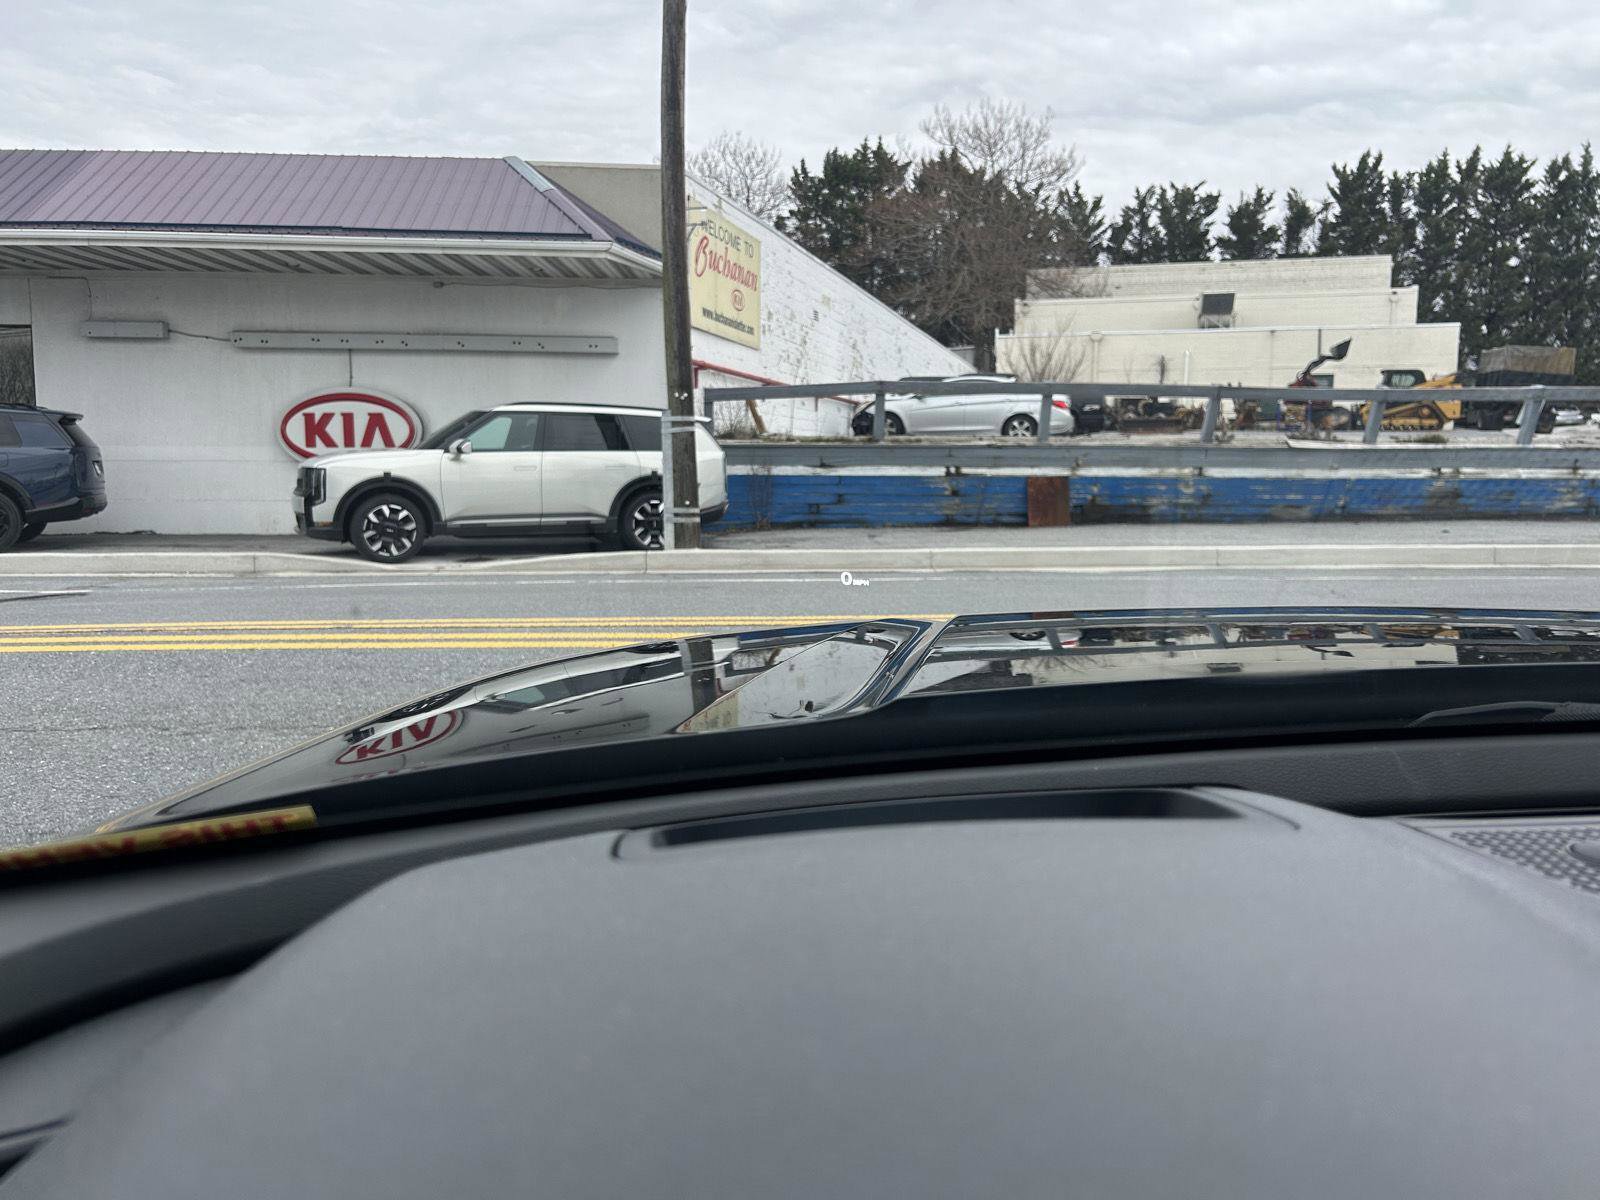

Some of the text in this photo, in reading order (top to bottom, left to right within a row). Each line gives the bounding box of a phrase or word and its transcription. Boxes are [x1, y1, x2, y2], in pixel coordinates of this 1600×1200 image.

[744, 240, 754, 258] TO
[695, 235, 758, 291] Buchanan
[303, 412, 396, 448] KIA
[841, 571, 852, 586] 0
